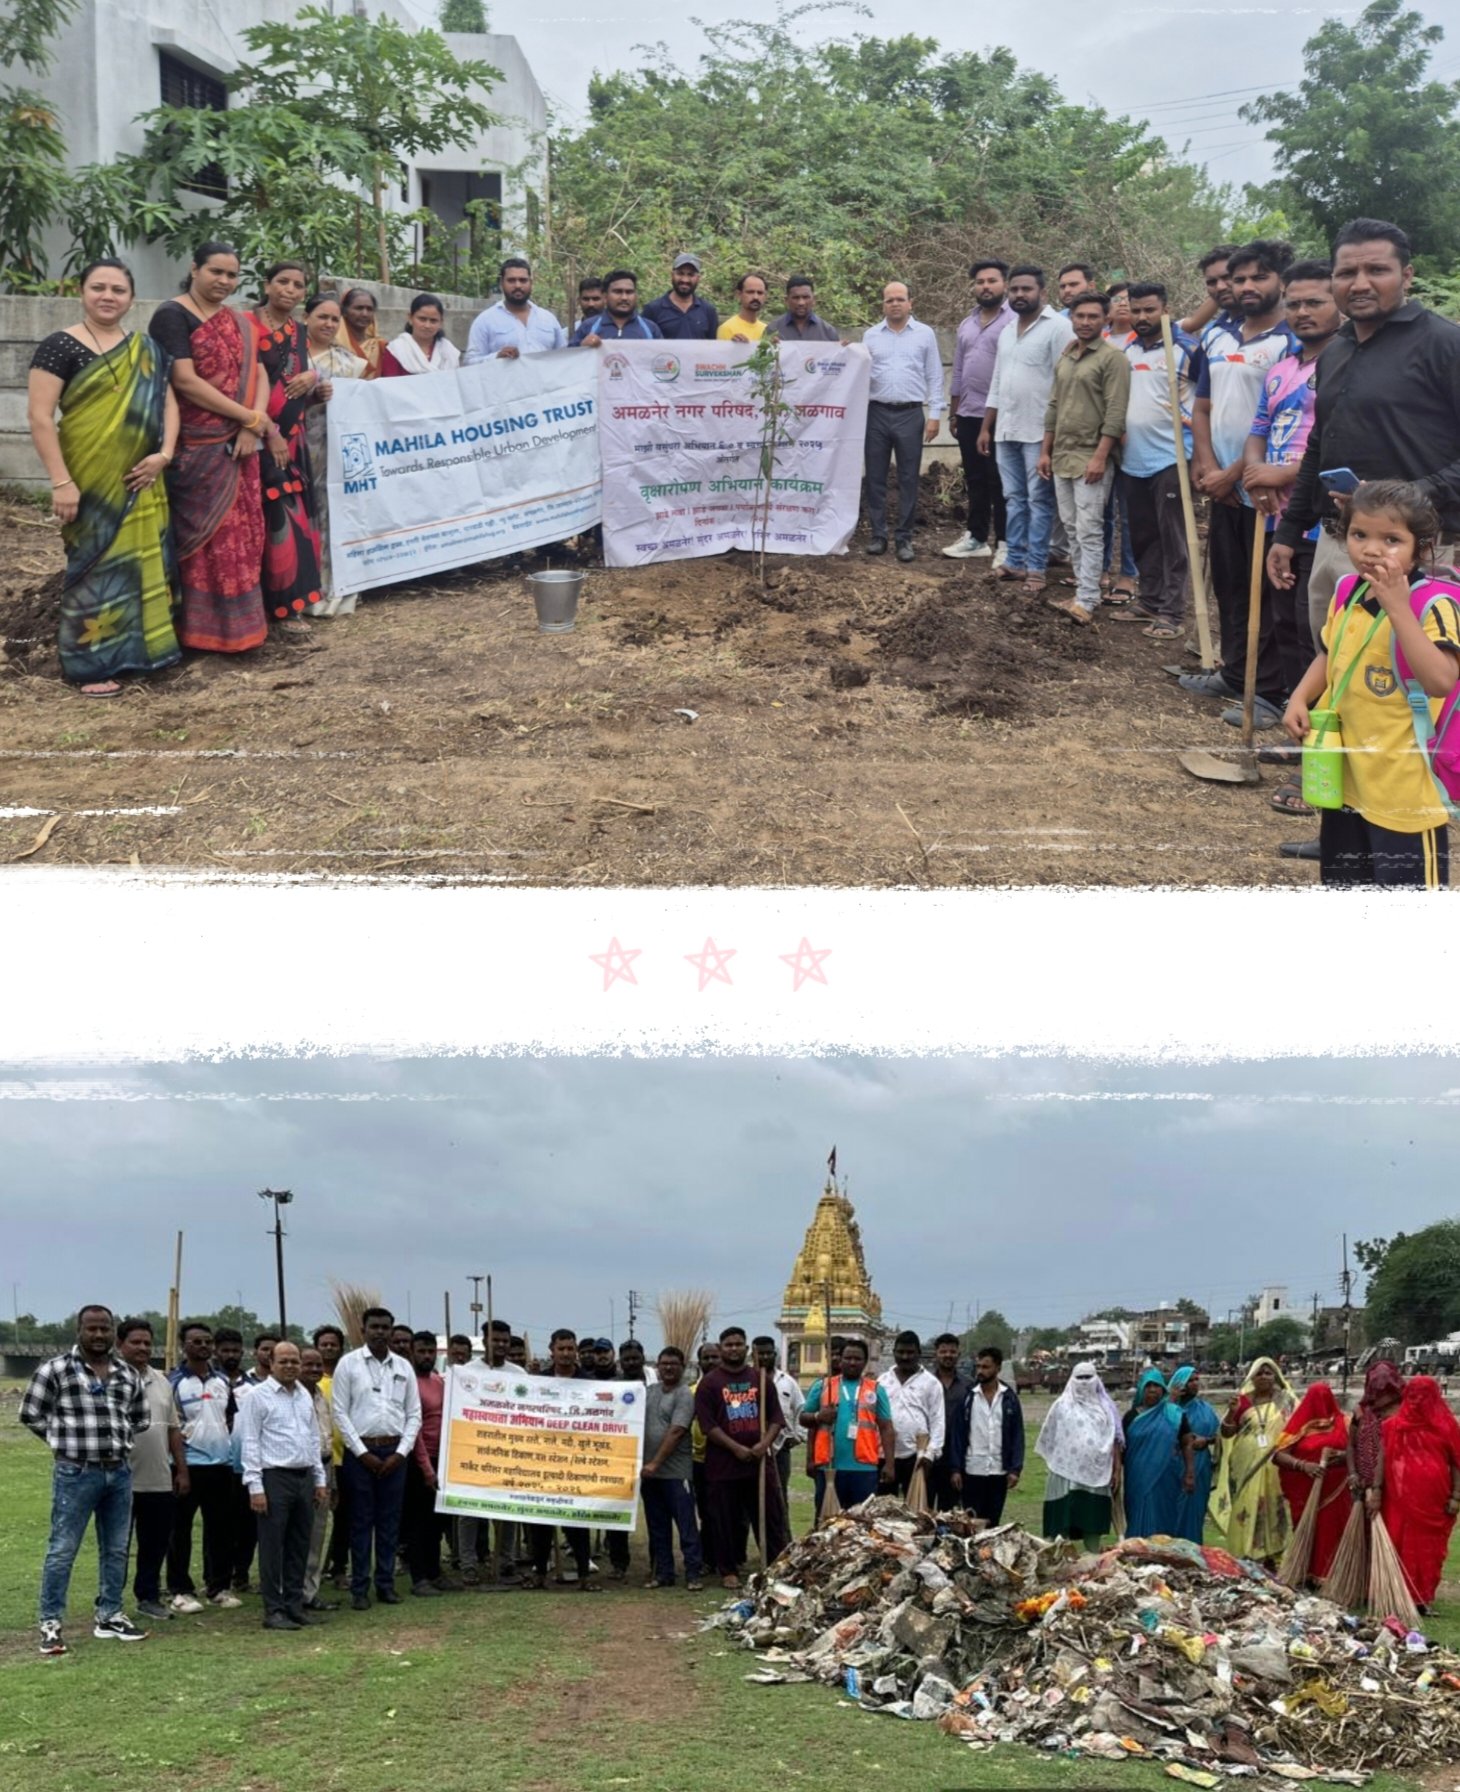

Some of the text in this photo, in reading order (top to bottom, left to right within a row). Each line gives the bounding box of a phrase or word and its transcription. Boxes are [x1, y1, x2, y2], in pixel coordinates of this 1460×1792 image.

[612, 400, 671, 419] अमळनेर
[674, 404, 706, 418] नगर
[711, 400, 758, 420] परिषद,
[375, 400, 594, 457] MAHILA HOUSING TRUST
[379, 424, 597, 477] Towards Responsible Urban Development
[343, 477, 378, 494] MHT
[639, 473, 825, 504] वृक्षारोपण अभियान कार्यक्रम
[546, 1419, 570, 1430] DEEP
[571, 1420, 600, 1432] CLEAN
[602, 1422, 629, 1434] DRIVE
